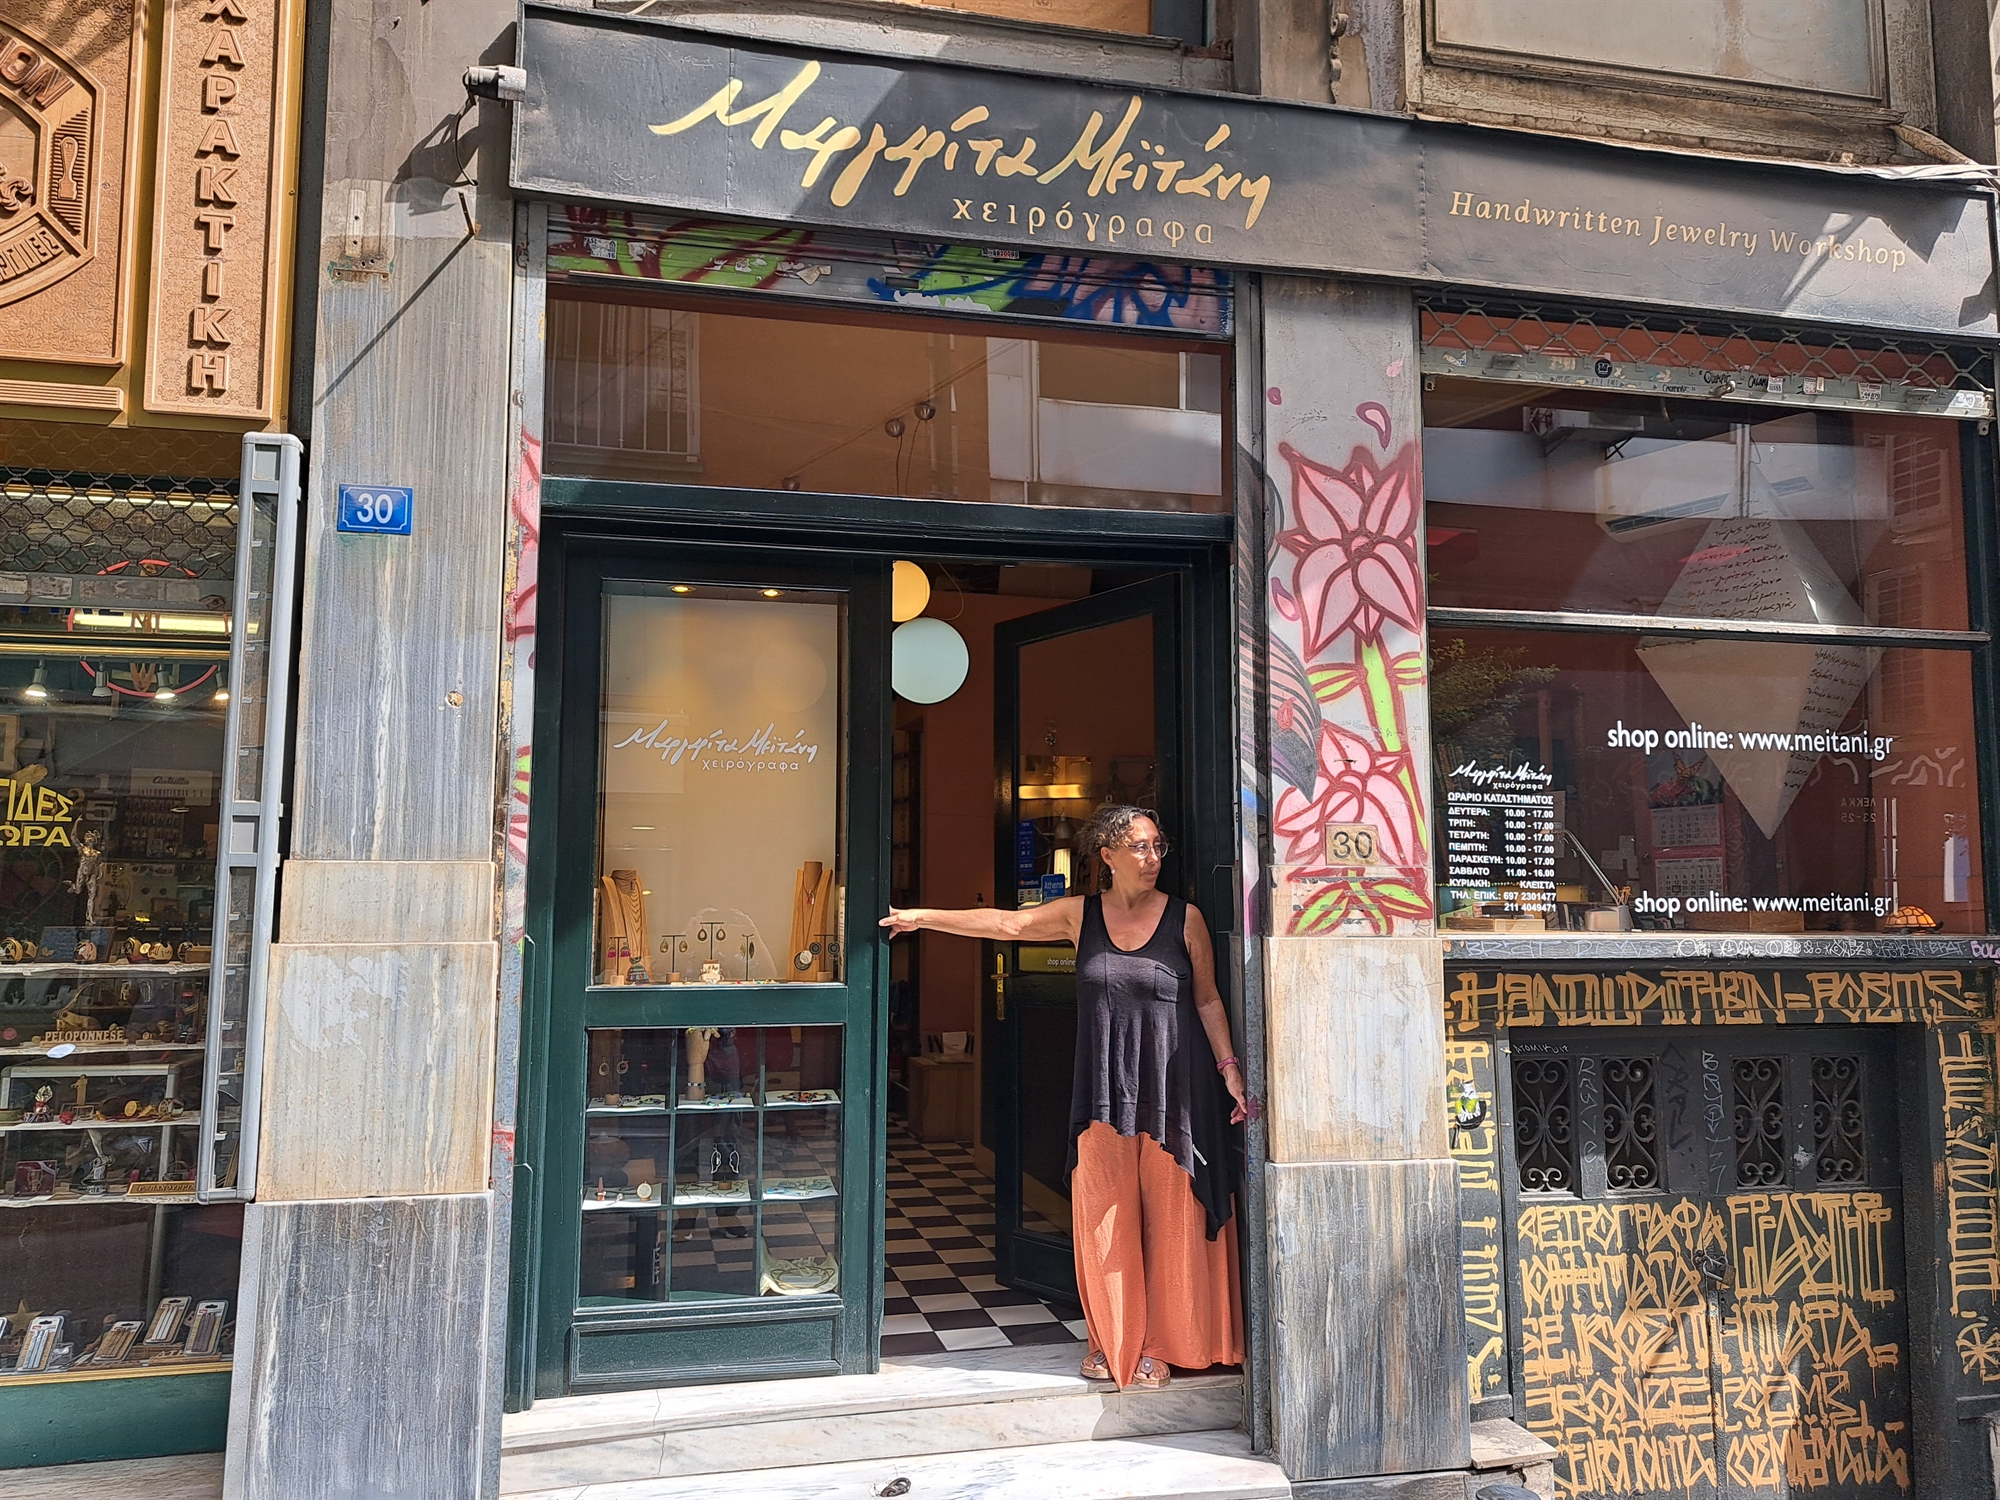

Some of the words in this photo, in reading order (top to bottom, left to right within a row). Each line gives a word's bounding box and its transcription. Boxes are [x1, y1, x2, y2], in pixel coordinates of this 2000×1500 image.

[952, 197, 1215, 248] χειρόγραφα
[1449, 190, 1642, 236] Handwritten
[1648, 215, 1758, 257] Jewelry
[1769, 228, 1907, 272] Workshop
[356, 492, 393, 524] 30
[1607, 720, 1659, 755] shop
[1664, 721, 1734, 750] online:
[1738, 728, 1894, 761] www.meitani.gr
[702, 757, 799, 773] χειρόγραφα
[1493, 781, 1543, 791] χειρόγραφα
[1447, 792, 1482, 802] ΩΡΑΡΙΟ
[1483, 793, 1554, 805] ΚΑΤΑΣΤΗΜΑΤΟΣ
[1448, 807, 1490, 816] ΔΕΥΤΕΡΑ:
[1504, 809, 1526, 817] 10.00
[1532, 810, 1554, 818] 17.00
[1448, 819, 1476, 828] ΤΡΙΤΗ:
[1504, 821, 1526, 830] 10.00
[1533, 822, 1554, 830] 17.00
[1448, 831, 1490, 840] ΤΕΤΑΡΤΗ:
[1504, 833, 1526, 841] 10.00
[1533, 833, 1554, 842] 17.00
[1333, 831, 1373, 859] 30
[1449, 843, 1488, 852] ΠΕΜΠΤΗ:
[1505, 844, 1526, 853] 10.00
[1533, 845, 1554, 854] 17.00
[1449, 855, 1503, 864] ΠΑΡΑΣΚΕΥΗ:
[1505, 857, 1527, 865] 10.00
[1533, 857, 1555, 866] 17.00
[1449, 867, 1490, 876] ΣΑΒΒΑΤΟ
[1506, 869, 1527, 877] 11.00
[1534, 869, 1555, 877] 16.00
[1044, 881, 1064, 890] Athens
[1519, 880, 1555, 890] ΚΛΕΙΣΤΑ
[1450, 891, 1472, 900] ΤΗΛ.
[1503, 892, 1519, 900] 697
[1520, 892, 1557, 901] 2301477
[1504, 903, 1519, 911] 211
[1521, 903, 1557, 913] 4049471
[1634, 889, 1681, 918] shop
[1685, 890, 1748, 912] online:
[1753, 892, 1892, 917] www.meitani.gr
[1046, 957, 1059, 967] shop
[45, 1029, 125, 1042] PELOPONNESE
